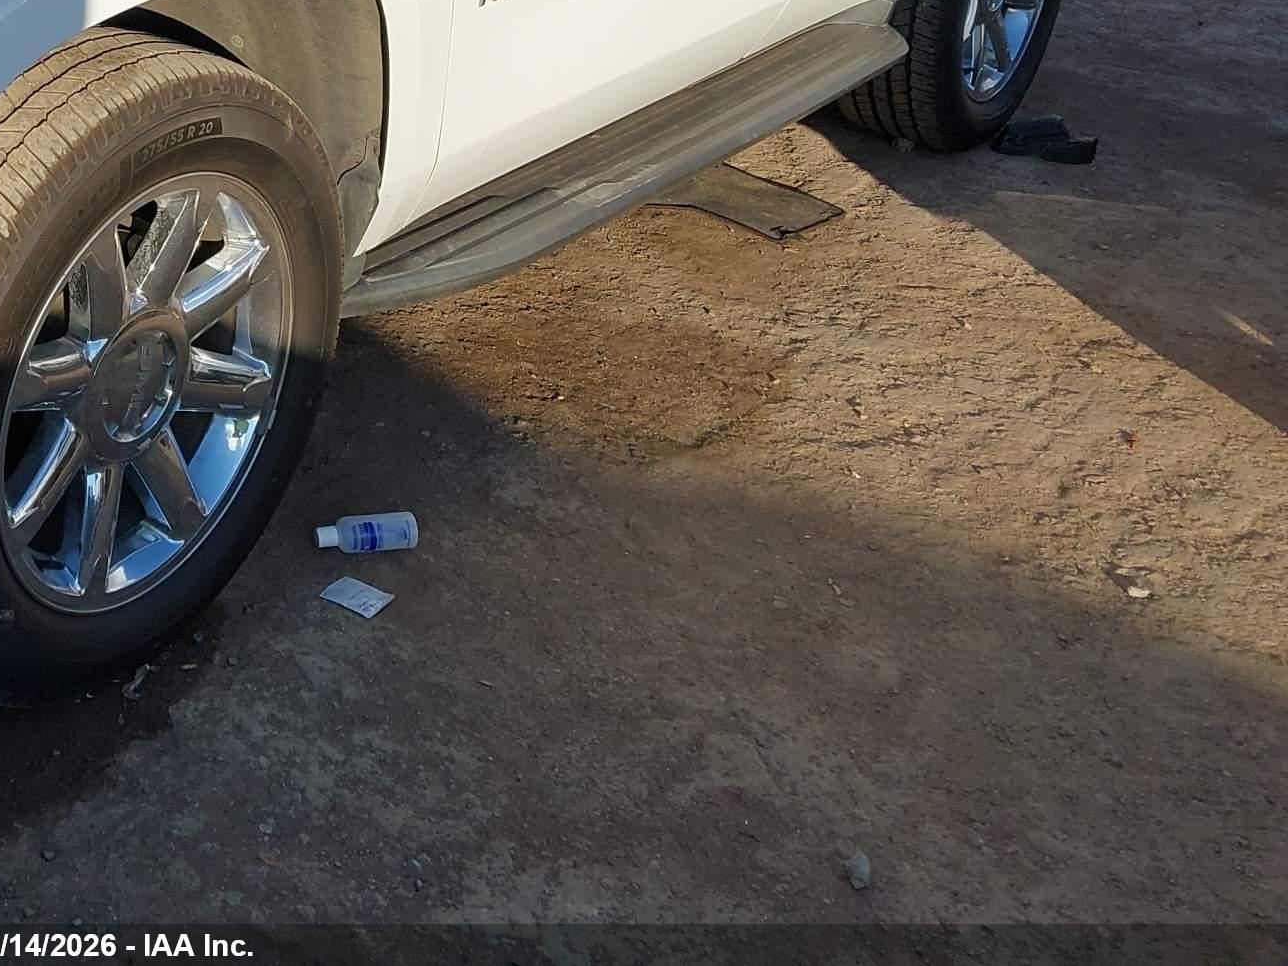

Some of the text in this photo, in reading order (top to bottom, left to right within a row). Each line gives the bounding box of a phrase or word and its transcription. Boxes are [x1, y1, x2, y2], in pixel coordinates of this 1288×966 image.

[141, 121, 214, 162] 275/55 R 20
